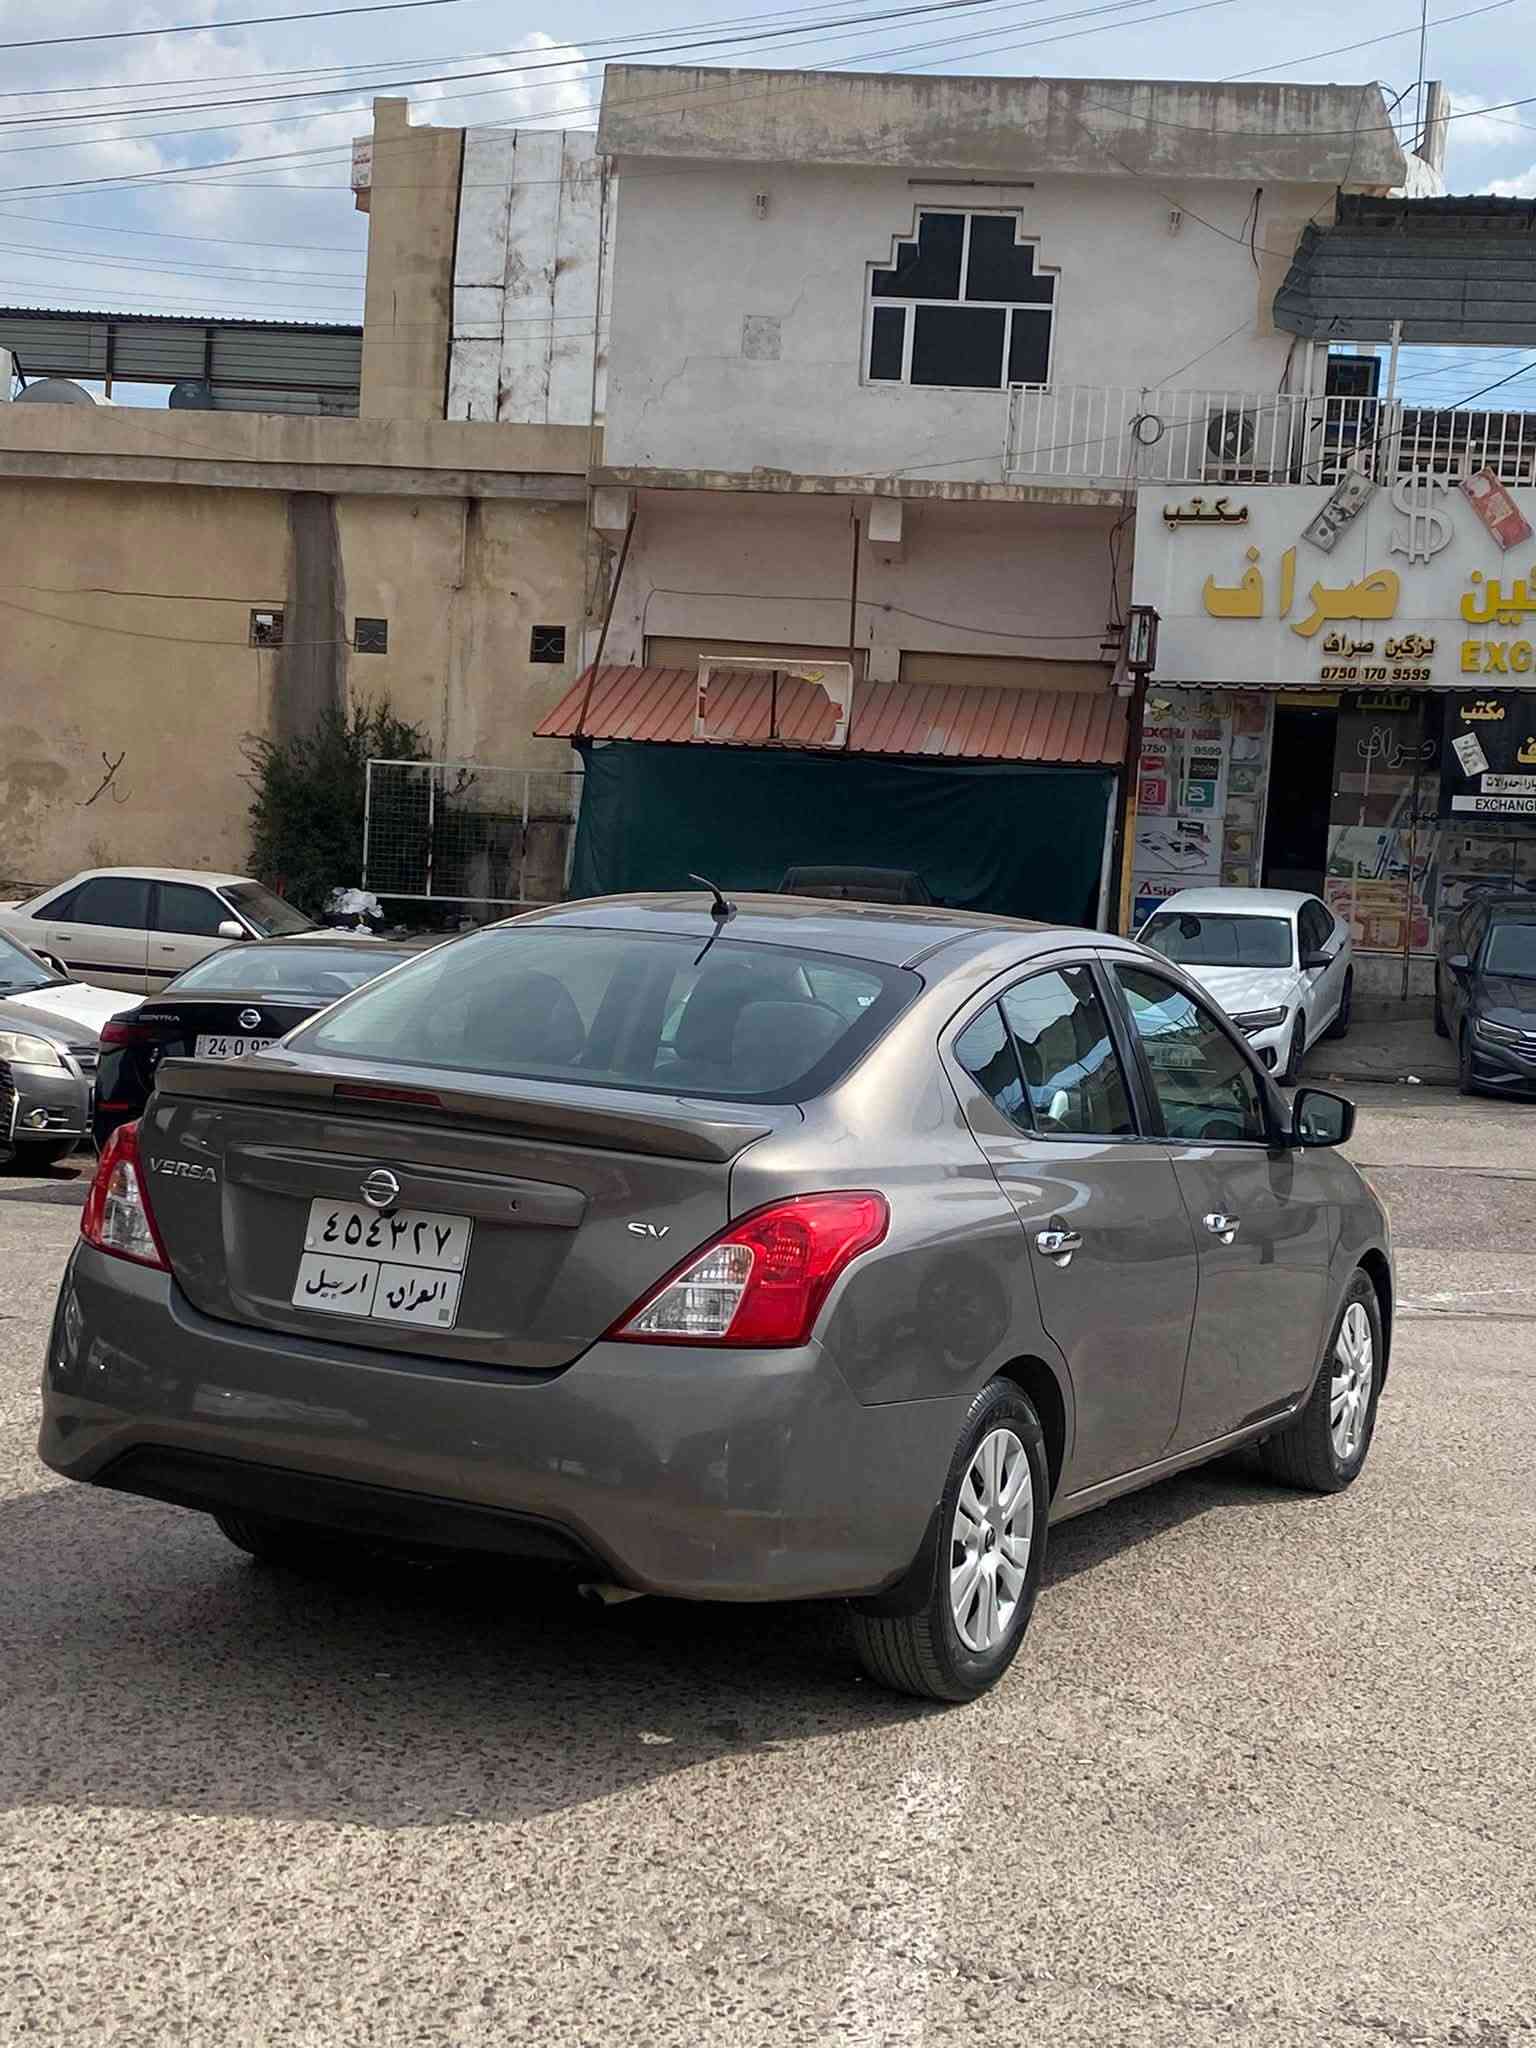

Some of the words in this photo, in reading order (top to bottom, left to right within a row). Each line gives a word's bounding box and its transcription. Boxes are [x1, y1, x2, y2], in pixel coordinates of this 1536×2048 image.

[1163, 497, 1249, 529] مكتب
[1203, 545, 1400, 637] صراف
[1323, 632, 1375, 658] صراف
[1461, 640, 1536, 673] EXC
[1321, 667, 1357, 679] 0750
[1364, 667, 1387, 680] 170
[1392, 668, 1431, 681] 9599
[208, 1038, 227, 1055] 24
[149, 1156, 217, 1184] VERSA
[322, 1211, 452, 1256] ٤٥٤٣٢٧
[627, 1222, 670, 1239] SV
[386, 1279, 446, 1311] العراق
